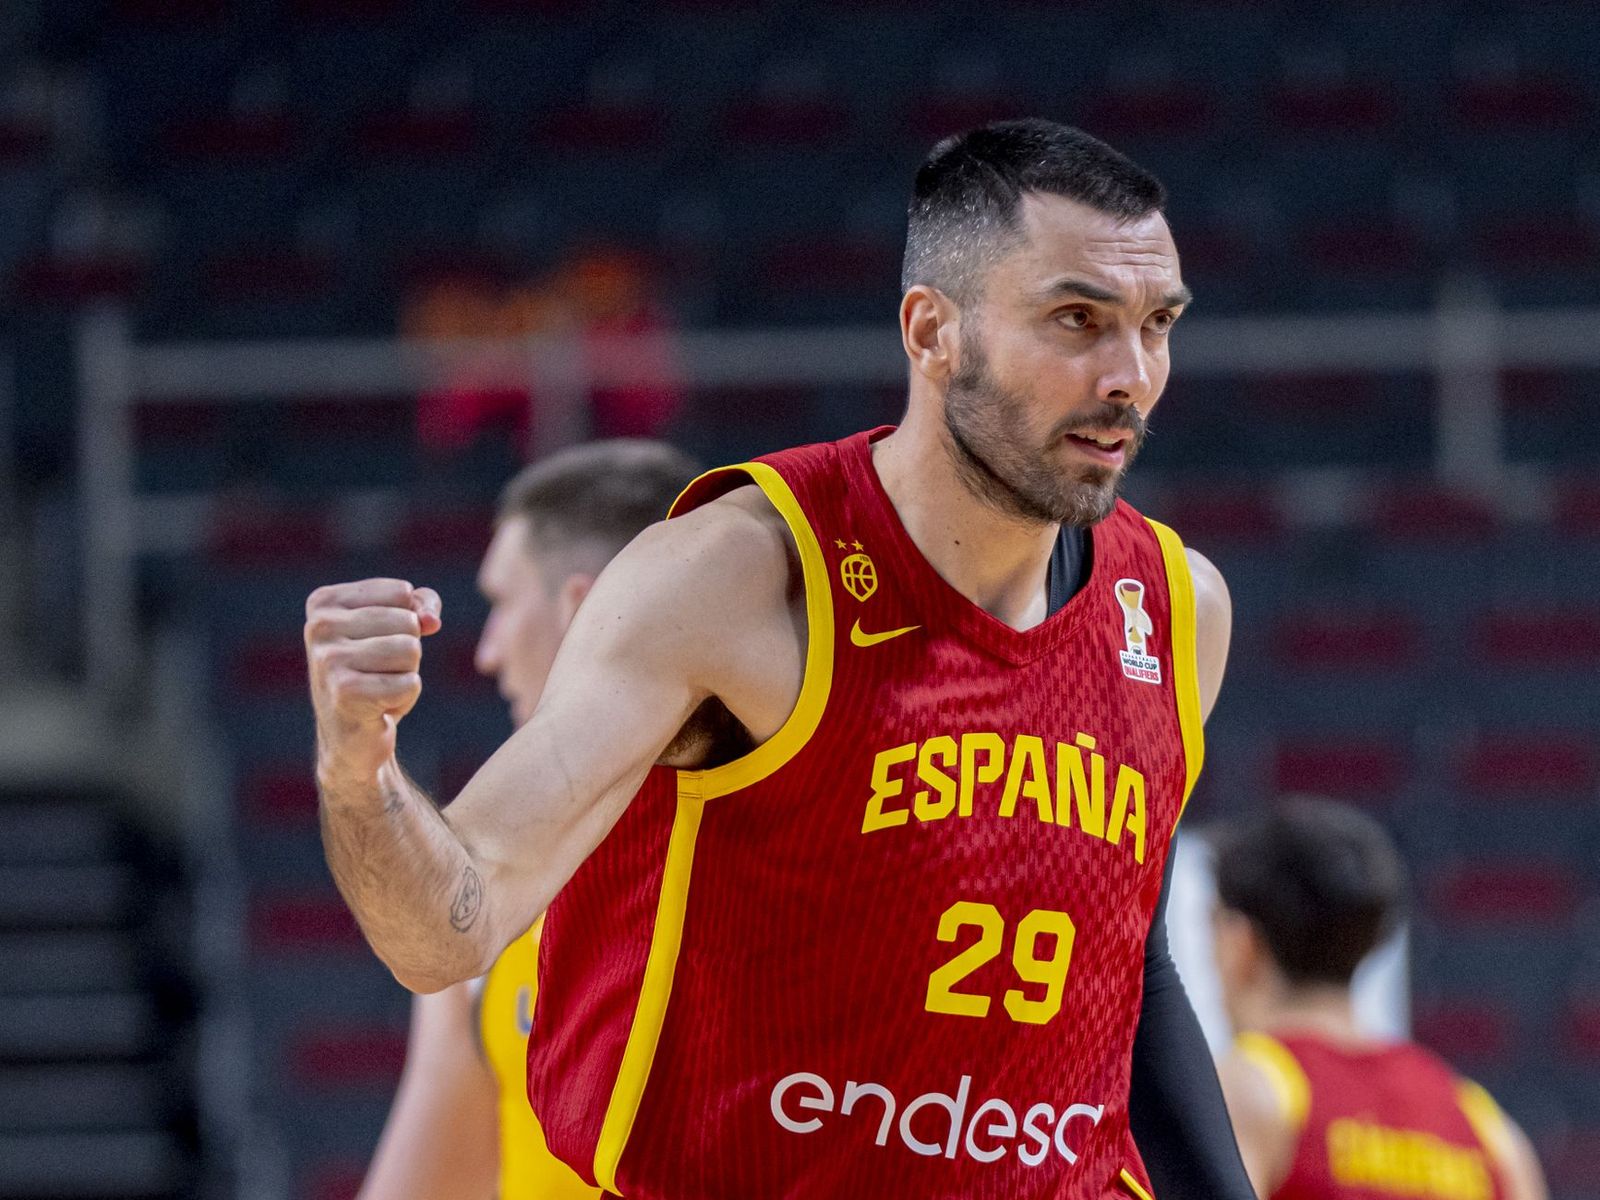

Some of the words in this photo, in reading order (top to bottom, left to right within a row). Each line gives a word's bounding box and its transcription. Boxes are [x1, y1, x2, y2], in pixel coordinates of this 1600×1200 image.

[1122, 657, 1144, 668] WORLD
[1144, 662, 1158, 670] CUP
[861, 731, 1146, 865] ESPAÑA
[924, 901, 1076, 1025] 29
